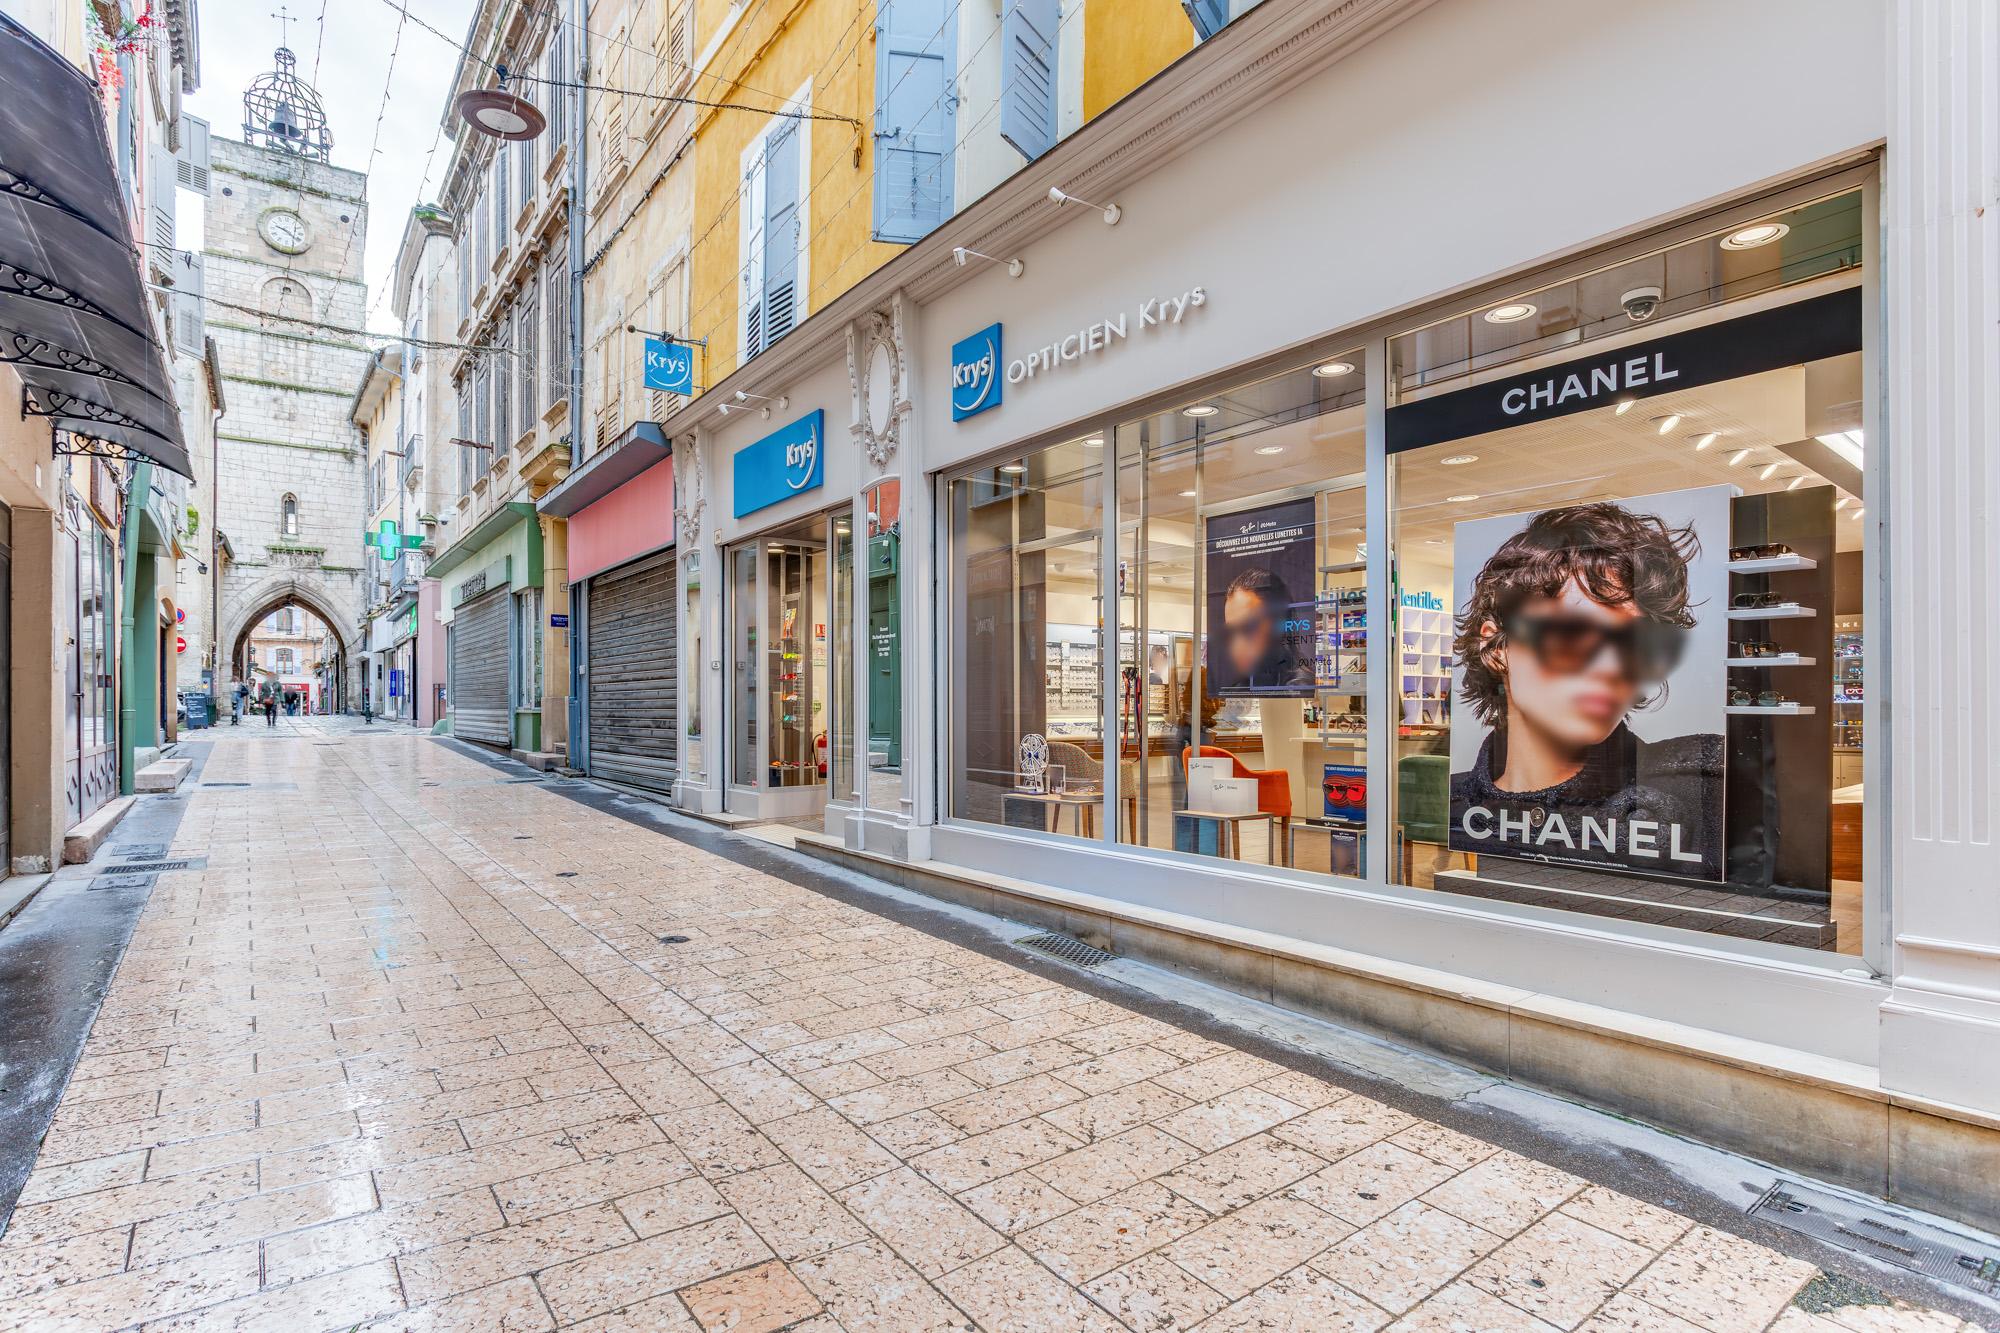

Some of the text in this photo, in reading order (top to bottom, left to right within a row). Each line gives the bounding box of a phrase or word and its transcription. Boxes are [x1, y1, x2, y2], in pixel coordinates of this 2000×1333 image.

[1007, 286, 1207, 384] OPTICIEN Krys
[647, 351, 686, 374] Krys
[953, 355, 990, 389] Krys
[1501, 352, 1679, 415] CHANEL
[786, 440, 813, 468] Krys
[1250, 533, 1274, 544] NOUVELLES
[1400, 588, 1443, 611] lentilles
[1462, 806, 1703, 863] CHANEL
